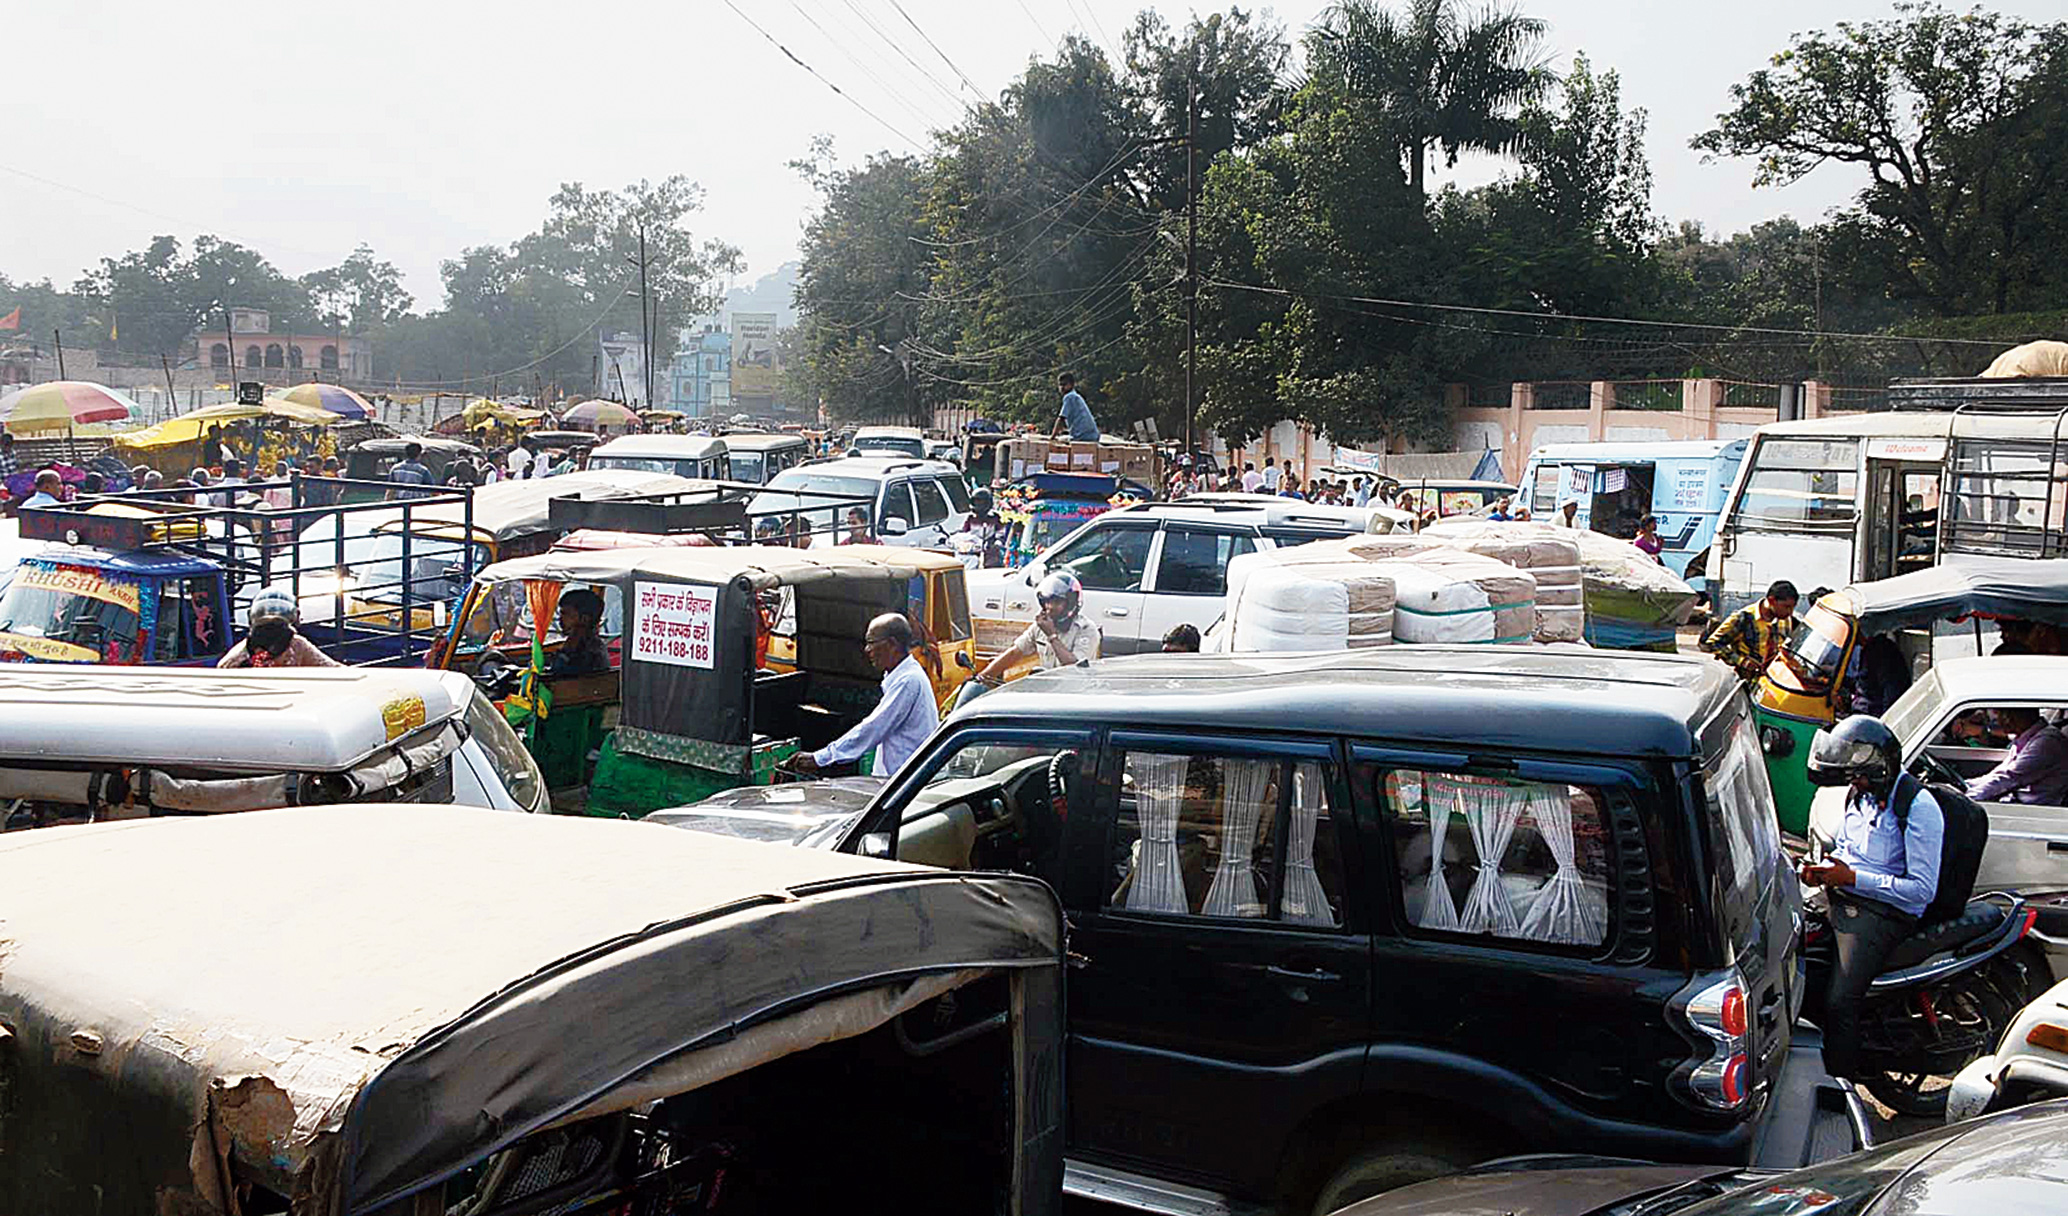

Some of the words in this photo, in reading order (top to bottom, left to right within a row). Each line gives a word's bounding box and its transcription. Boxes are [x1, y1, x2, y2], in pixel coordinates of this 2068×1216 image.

[1885, 443, 1928, 453] Welcome
[23, 569, 104, 593] KHUSHI
[641, 587, 656, 608] सभी
[657, 594, 676, 612] प्रकार
[676, 590, 684, 610] के
[685, 590, 712, 616] विज्ञापन
[641, 614, 650, 634] के
[652, 613, 666, 637] लिए
[667, 618, 693, 640] सम्पर्क
[639, 636, 709, 661] 9211-188-188
